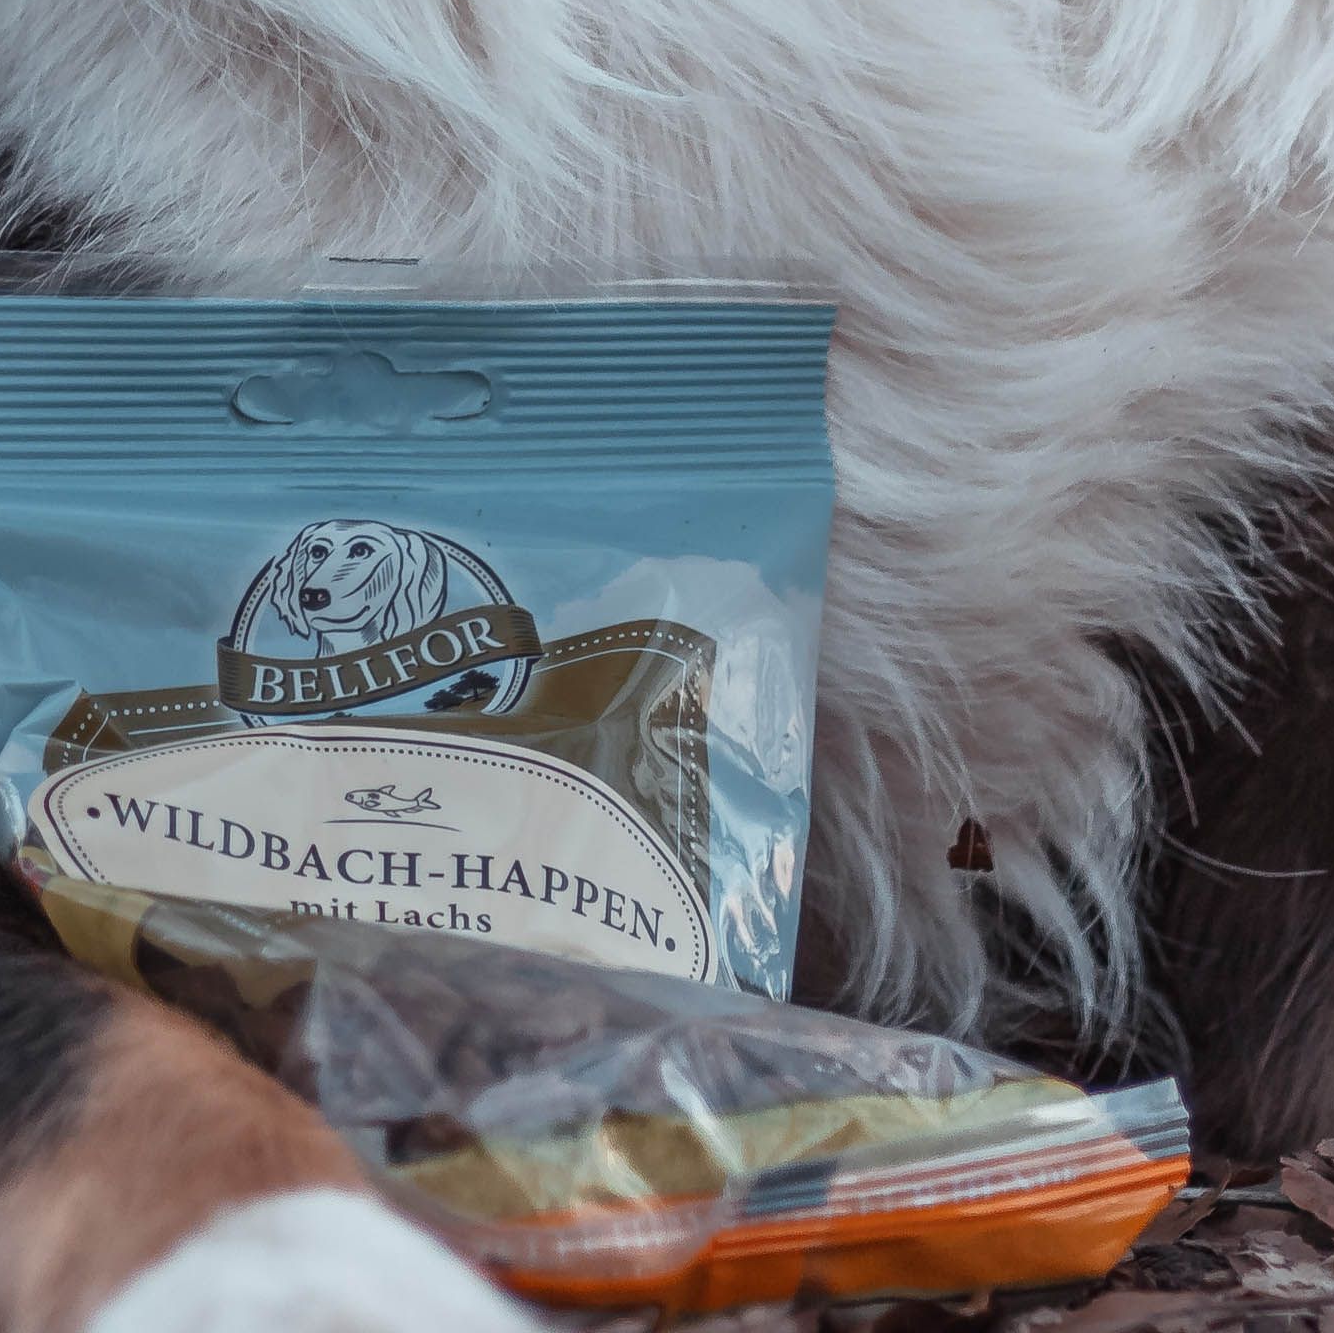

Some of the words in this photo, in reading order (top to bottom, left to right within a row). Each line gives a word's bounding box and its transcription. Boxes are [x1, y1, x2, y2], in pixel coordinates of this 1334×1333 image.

[248, 617, 506, 703] BELLFOR
[105, 793, 665, 945] WILDBACH-HAPPEN
[290, 898, 358, 921] mit
[375, 900, 492, 933] Lachs
